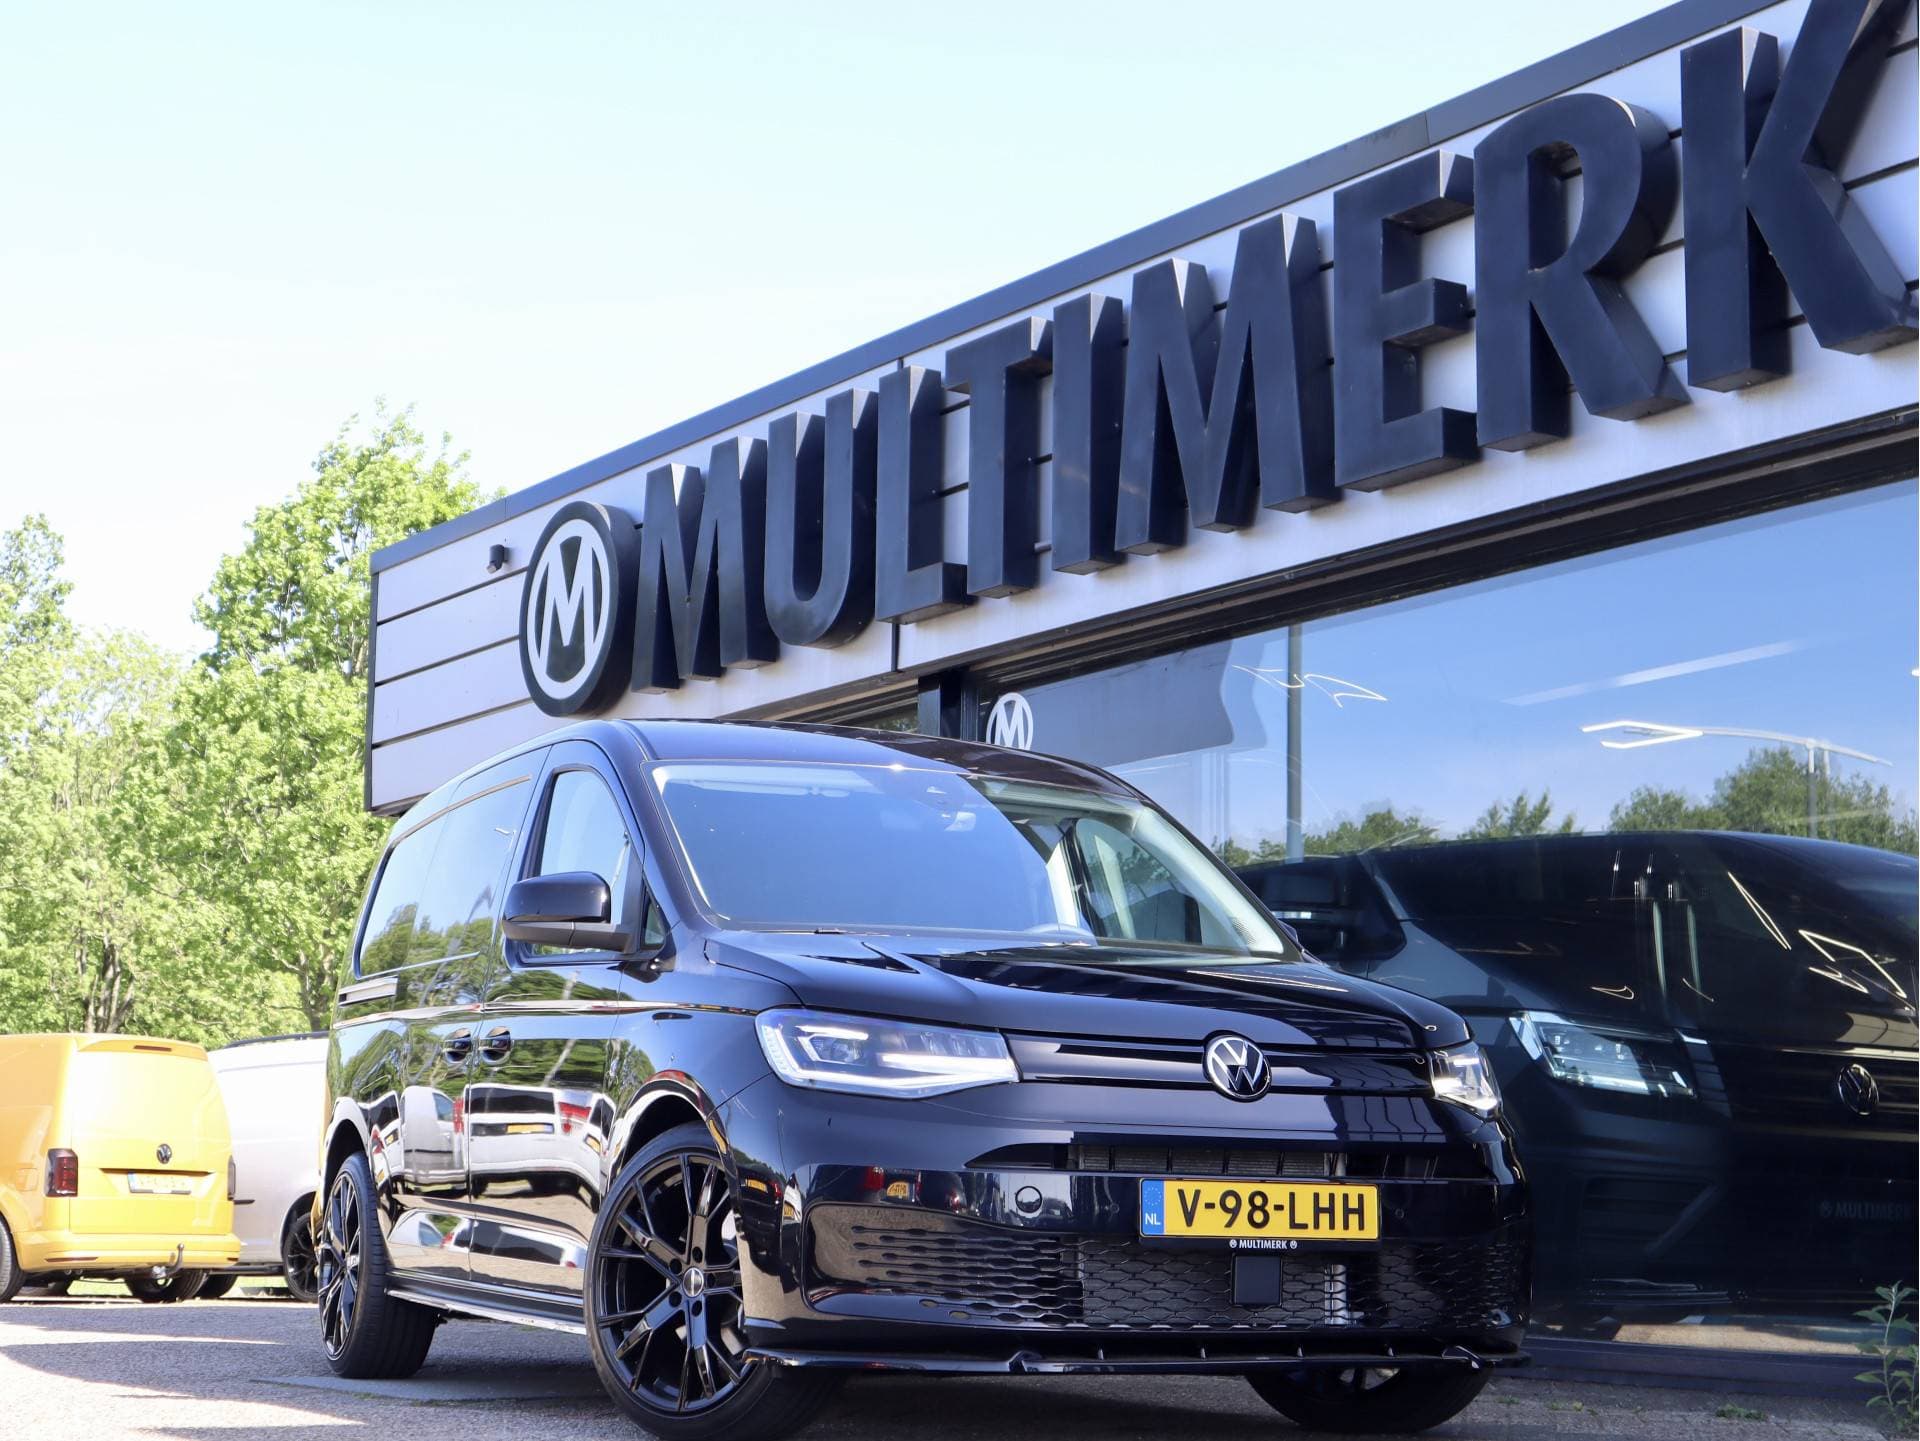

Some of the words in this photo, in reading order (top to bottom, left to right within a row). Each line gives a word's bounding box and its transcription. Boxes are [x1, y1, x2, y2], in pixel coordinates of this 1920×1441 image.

[631, 0, 1919, 692] MULTIMERK
[1145, 1213, 1161, 1226] NL
[1177, 1188, 1365, 1231] V-98-LHH
[1239, 1239, 1288, 1250] MULTIMERK
